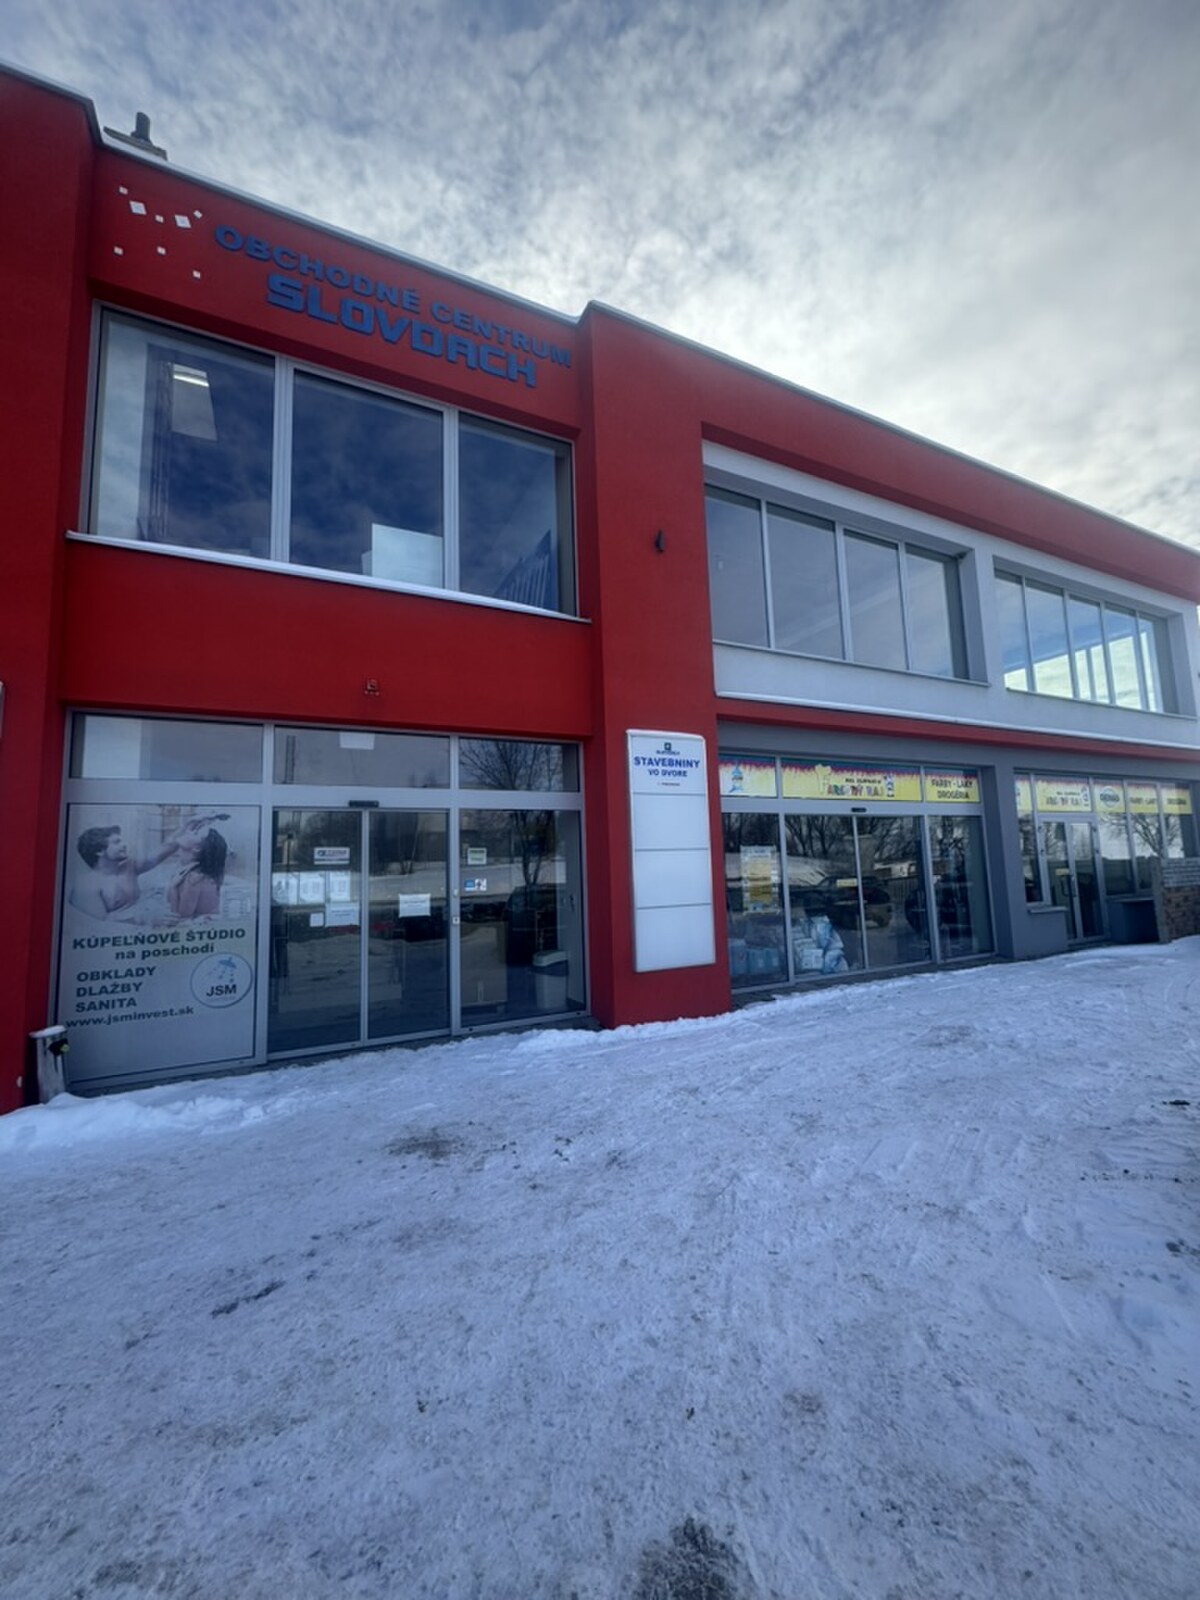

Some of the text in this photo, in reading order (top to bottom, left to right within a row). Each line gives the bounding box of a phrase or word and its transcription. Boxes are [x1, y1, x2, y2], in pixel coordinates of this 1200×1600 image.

[214, 224, 571, 368] OBCHODNÉ CENTRUM
[266, 274, 537, 388] SLOVDACH
[633, 756, 700, 768] STAVEBNINY
[661, 769, 688, 777] DVORE
[72, 928, 246, 950] KÚPEĽŇOVÉ ŠTÚDIO
[115, 943, 214, 960] na poschodí
[76, 966, 156, 982] OBKLADY
[76, 981, 143, 998] DLAŽBY
[206, 984, 237, 997] JSM
[75, 997, 137, 1013] SANITA
[65, 1006, 194, 1028] www.jsminvest.sk
